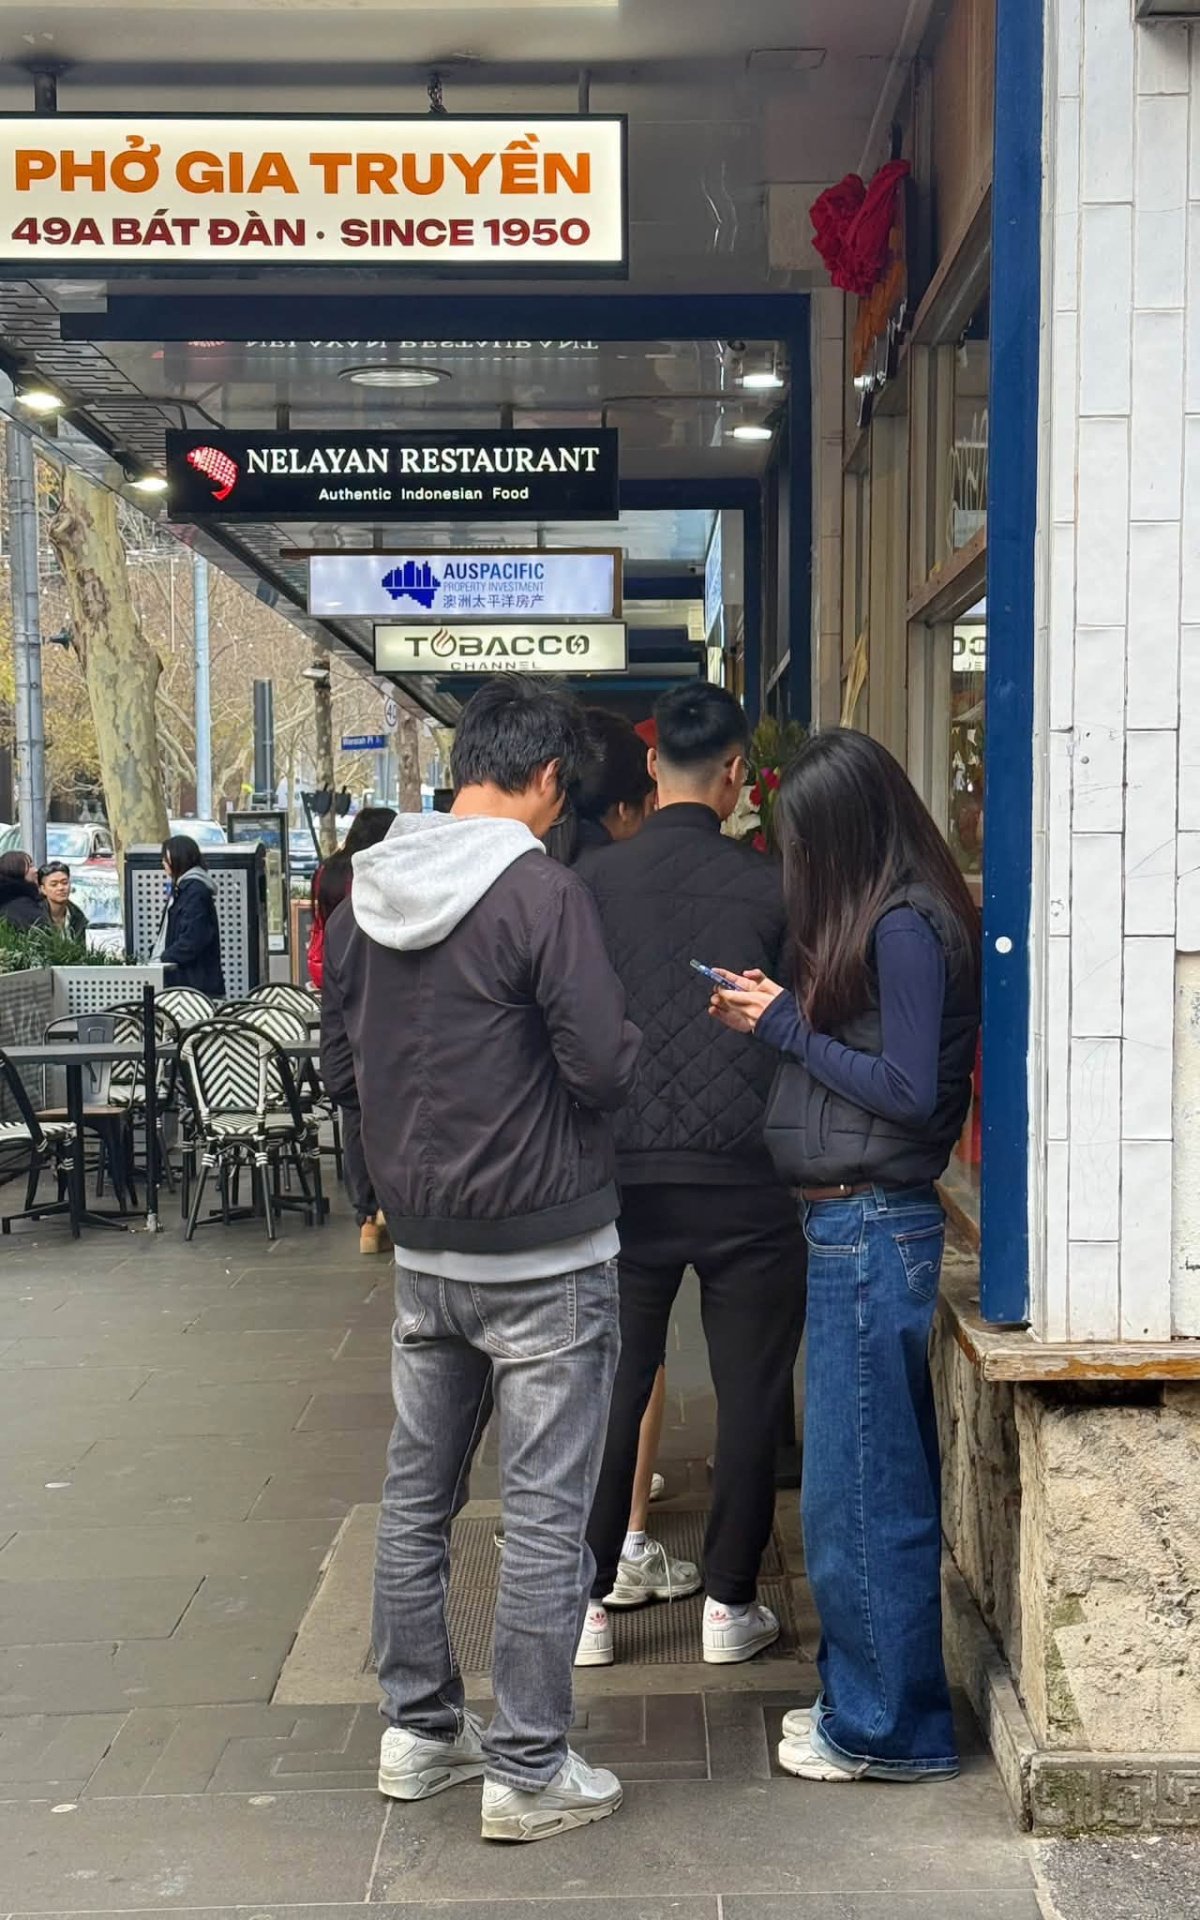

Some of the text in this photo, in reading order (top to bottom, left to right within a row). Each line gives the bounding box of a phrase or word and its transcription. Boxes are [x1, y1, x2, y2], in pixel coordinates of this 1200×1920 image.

[15, 133, 590, 195] PHỞ GIA TRUYỀN
[12, 208, 591, 247] 49A BÁT ĐÀN SINCE 1950
[247, 447, 600, 474] NELAYAN RESTAURANT
[318, 486, 529, 501] Authentic Indonesian Food
[443, 562, 545, 580] AUSPACIFIC
[443, 581, 544, 593] PROPERTY INVESTMENT
[443, 594, 545, 609] 澳洲太平洋房产
[405, 628, 590, 657] TOBACCO
[450, 660, 542, 670] CHANNEL
